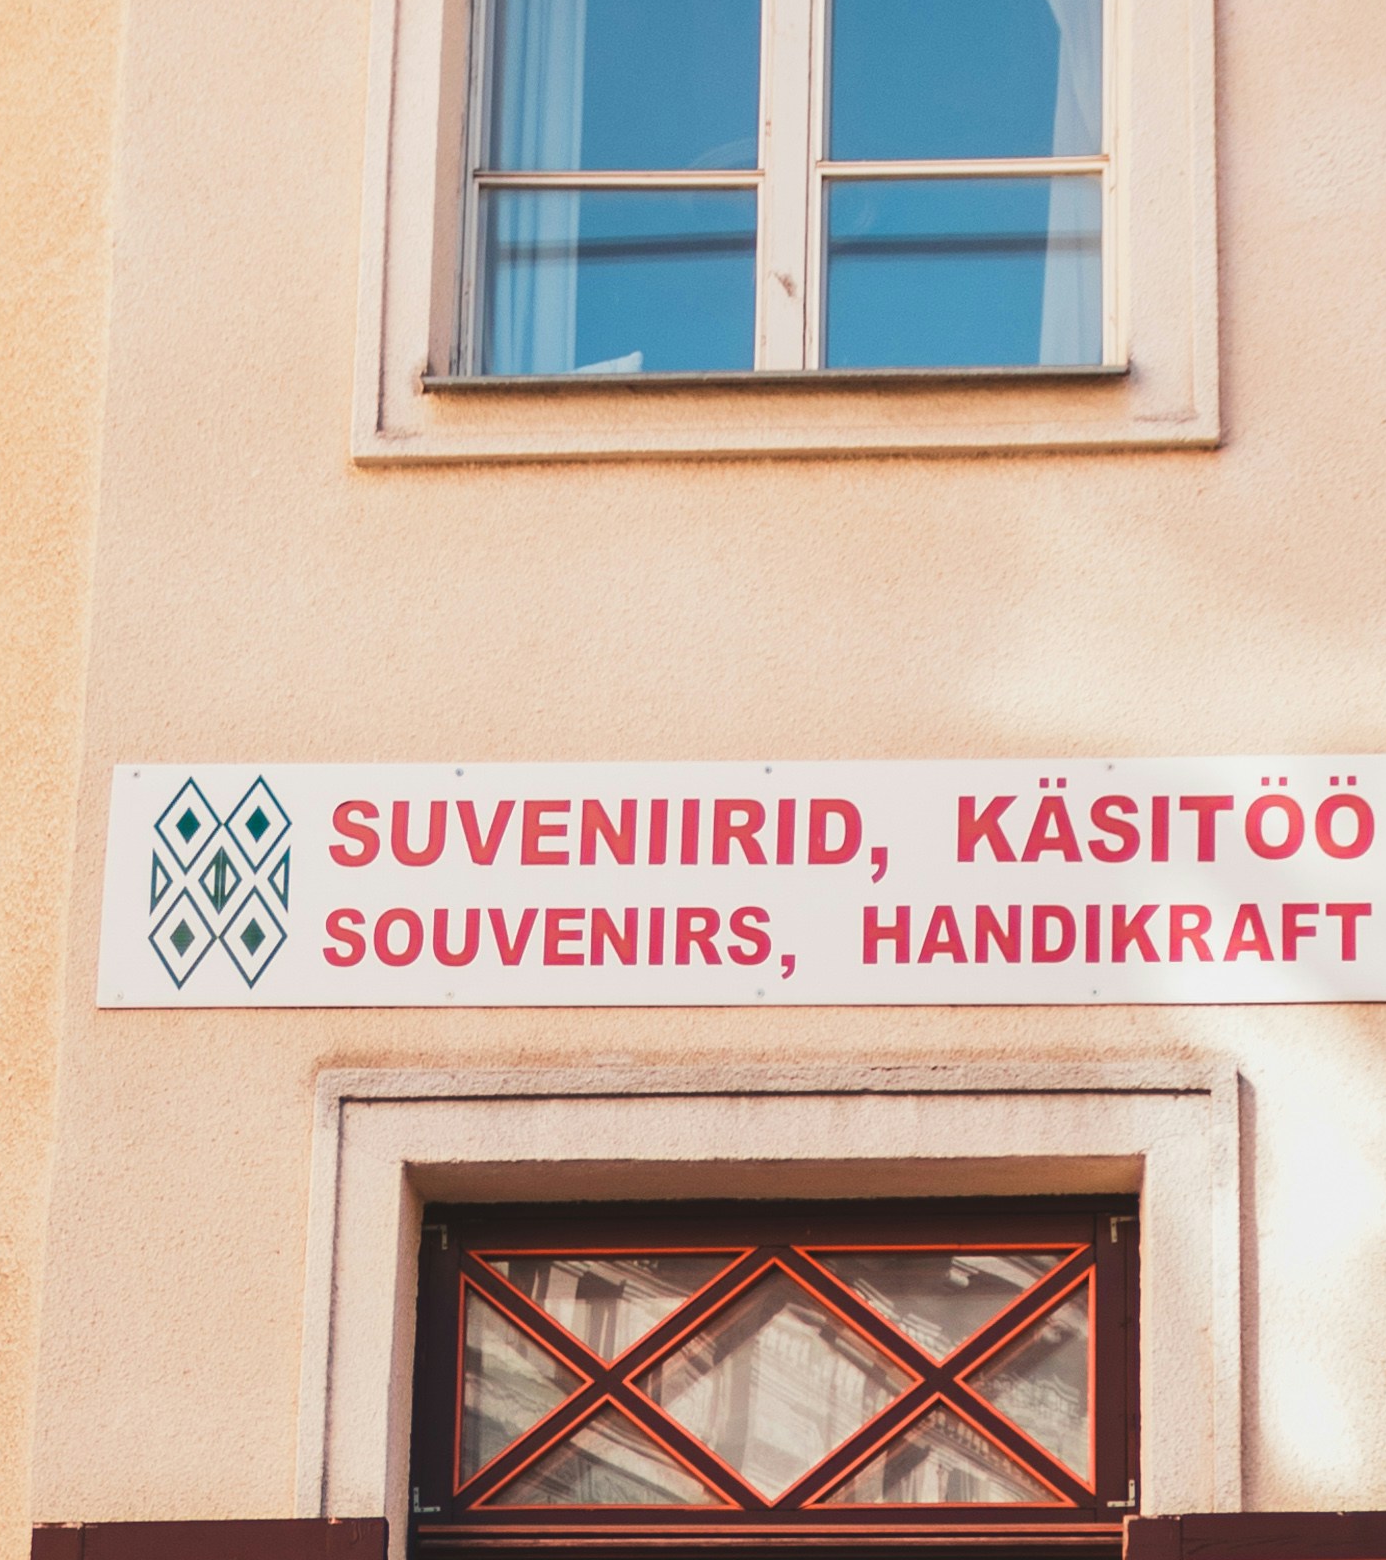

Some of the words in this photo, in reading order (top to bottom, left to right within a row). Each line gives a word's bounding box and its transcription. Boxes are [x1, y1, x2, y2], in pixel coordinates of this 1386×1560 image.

[328, 797, 890, 883] SUVENIIRID,
[956, 776, 1377, 864] KÄSITÖÖ
[322, 904, 797, 978] SOUVENIRS,
[862, 902, 1373, 965] HANDIKRAFT
